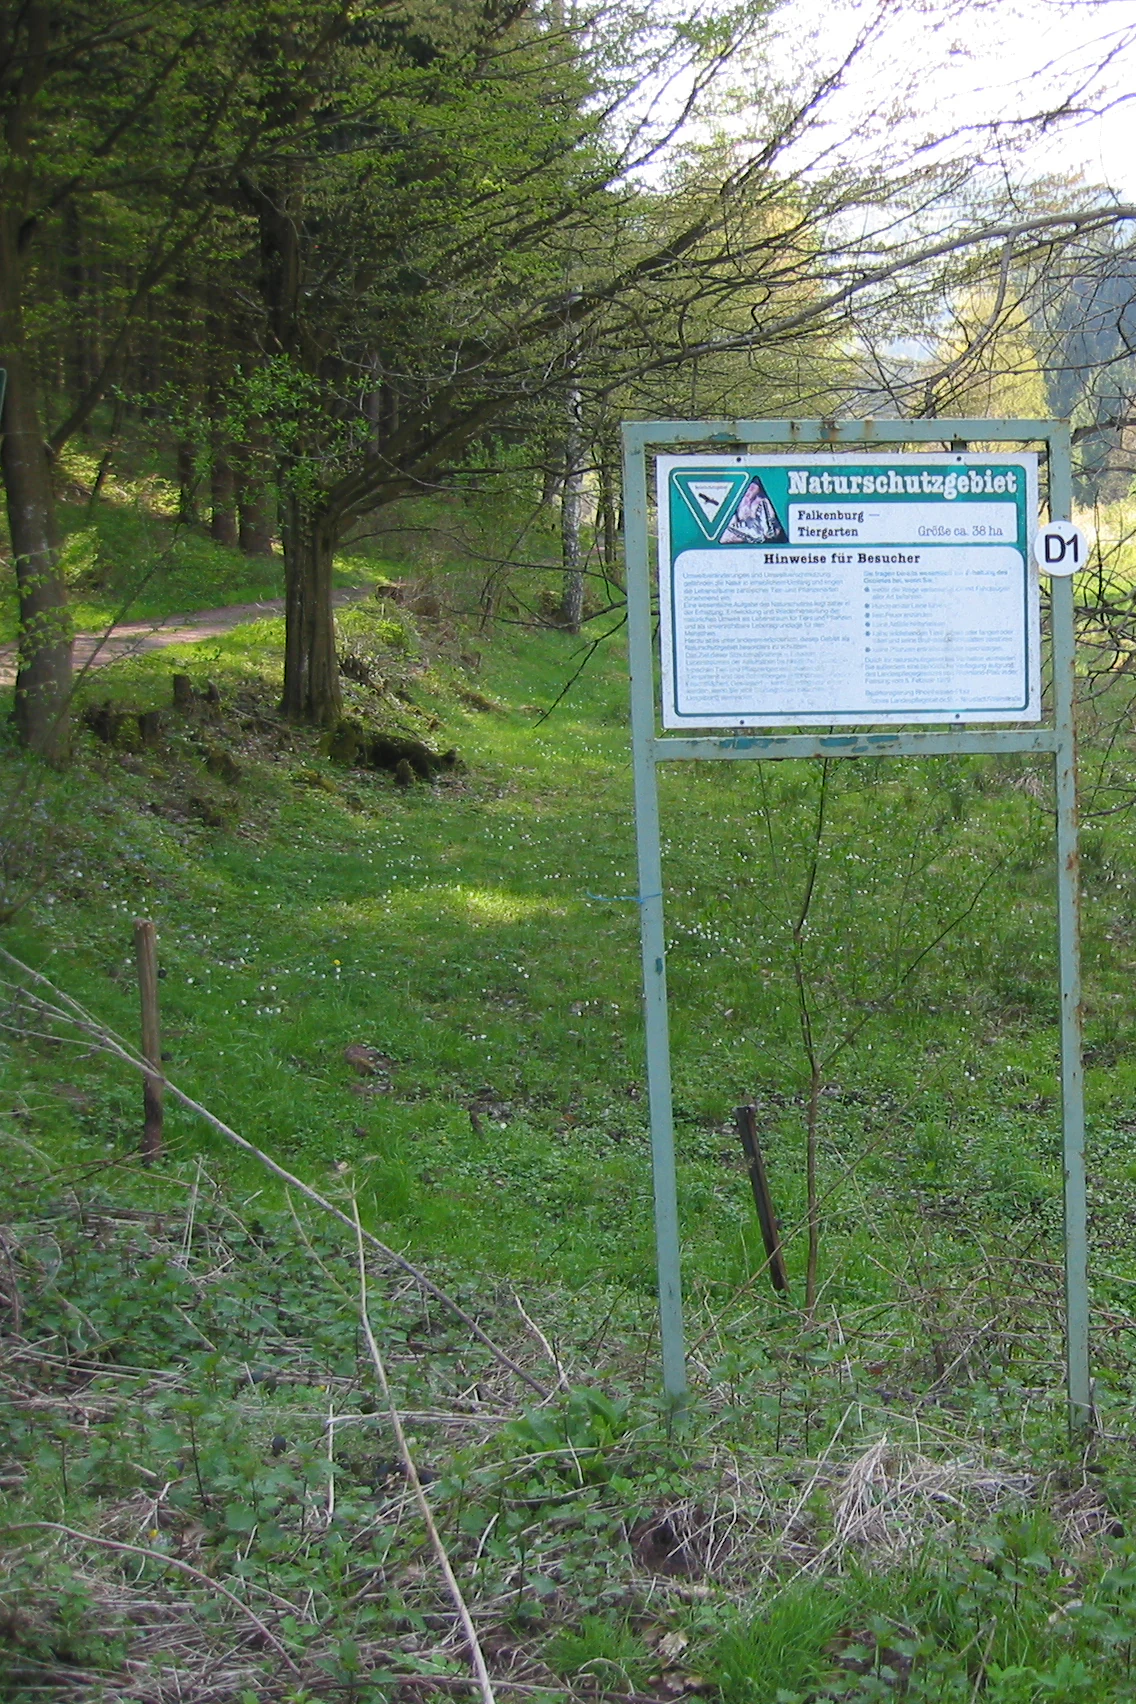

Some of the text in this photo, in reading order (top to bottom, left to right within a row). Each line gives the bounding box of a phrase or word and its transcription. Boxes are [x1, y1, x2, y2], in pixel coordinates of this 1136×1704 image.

[787, 469, 1018, 499] Naturschutzgebiet
[797, 510, 864, 523] Falkenburg
[797, 526, 859, 539] Tiergarten
[917, 525, 950, 537] Größe
[972, 525, 986, 537] 38
[989, 525, 1004, 537] ha
[1044, 533, 1080, 564] D1
[763, 552, 921, 565] Hinweise für Besucher
